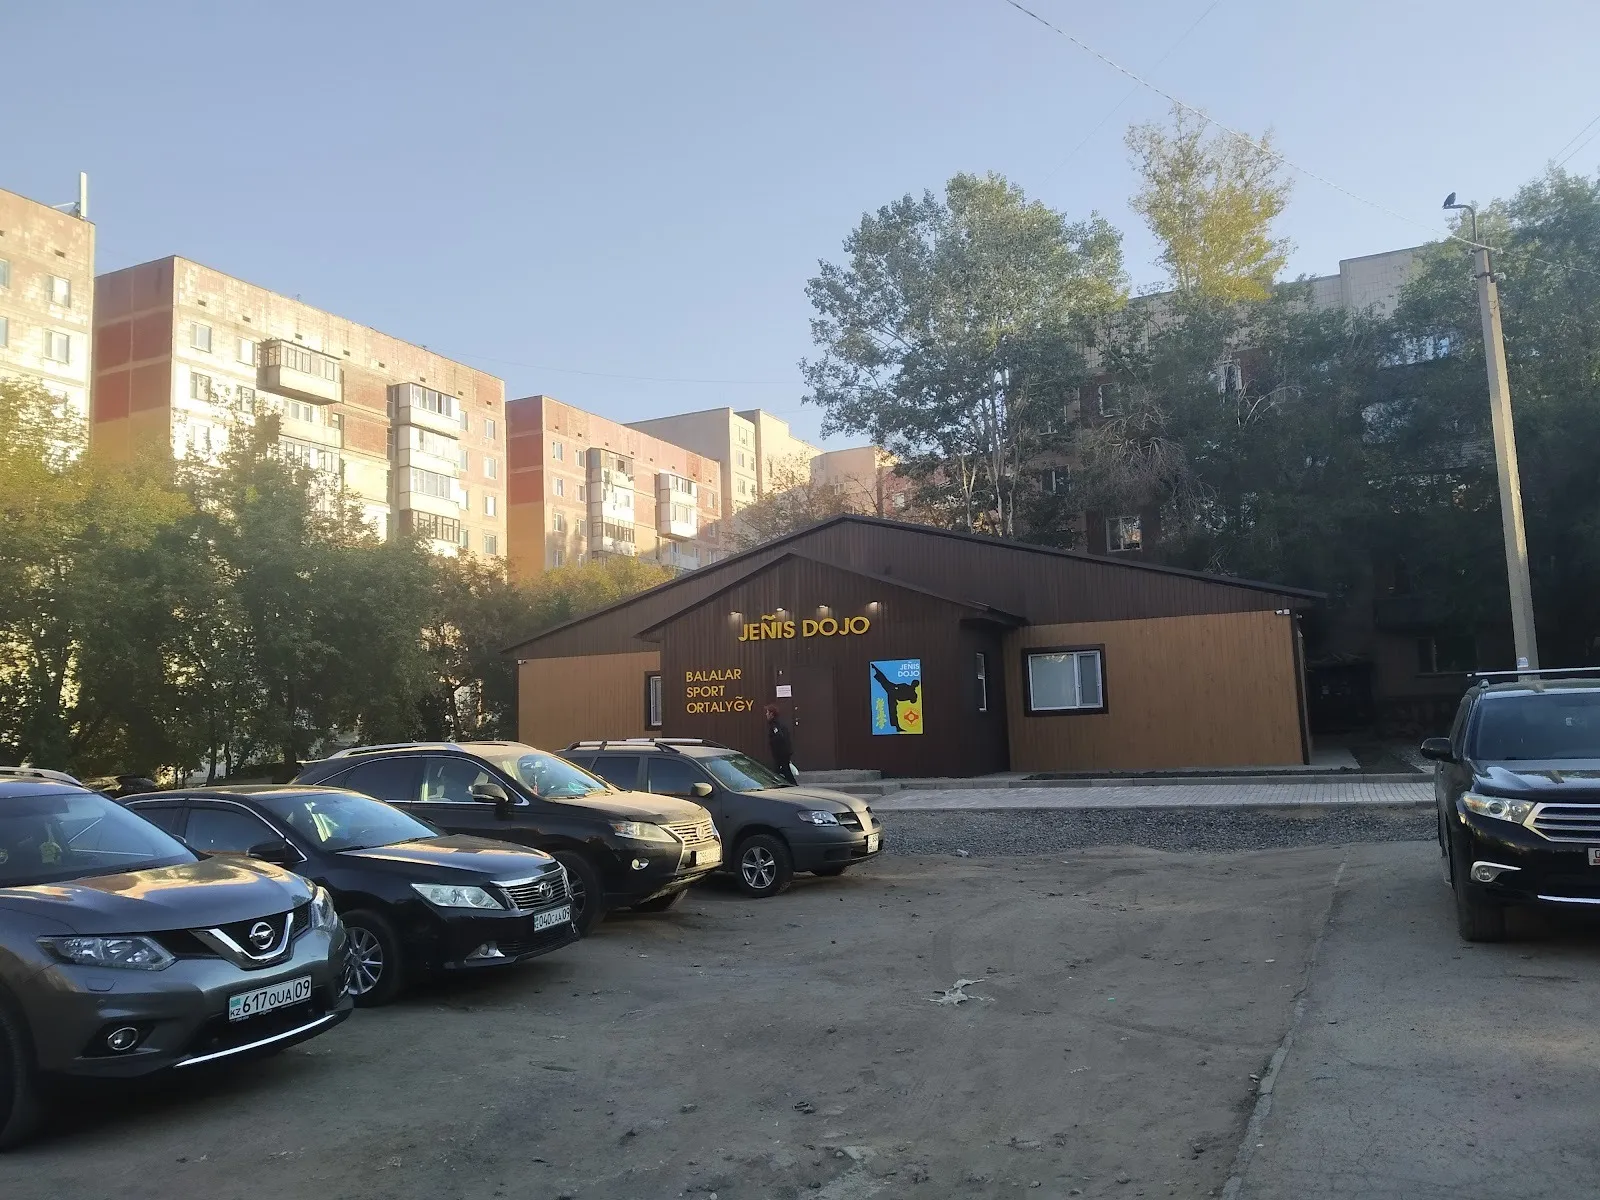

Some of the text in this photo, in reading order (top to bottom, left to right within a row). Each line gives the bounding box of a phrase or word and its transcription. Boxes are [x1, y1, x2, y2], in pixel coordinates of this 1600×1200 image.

[738, 614, 870, 642] JEÑIS DOJO
[685, 668, 742, 682] BALALAR
[686, 685, 725, 698] SPORT
